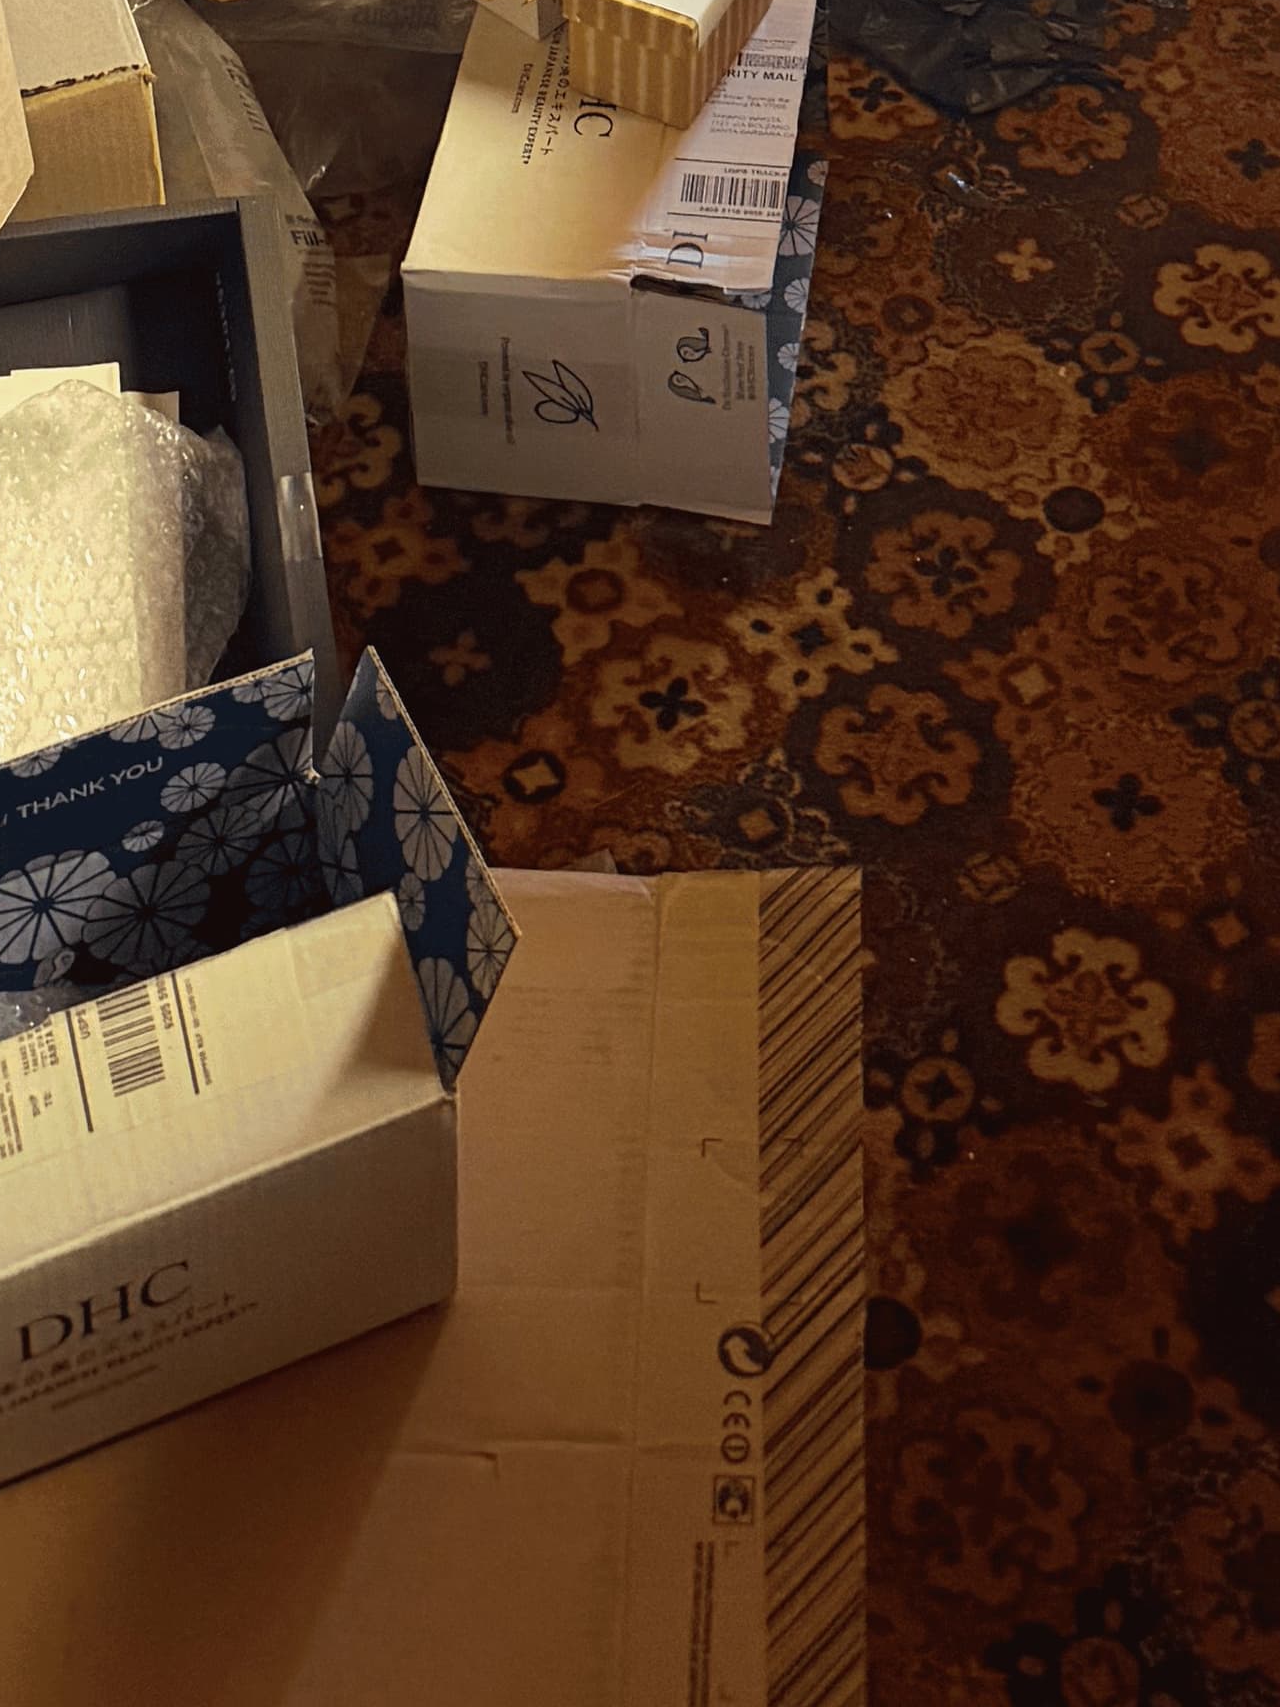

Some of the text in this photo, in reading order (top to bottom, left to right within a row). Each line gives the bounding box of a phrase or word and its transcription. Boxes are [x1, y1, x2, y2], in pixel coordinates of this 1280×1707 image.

[762, 70, 799, 83] MAIL
[15, 773, 108, 821] THANK
[110, 754, 166, 794] YOU
[16, 1257, 198, 1365] DHC
